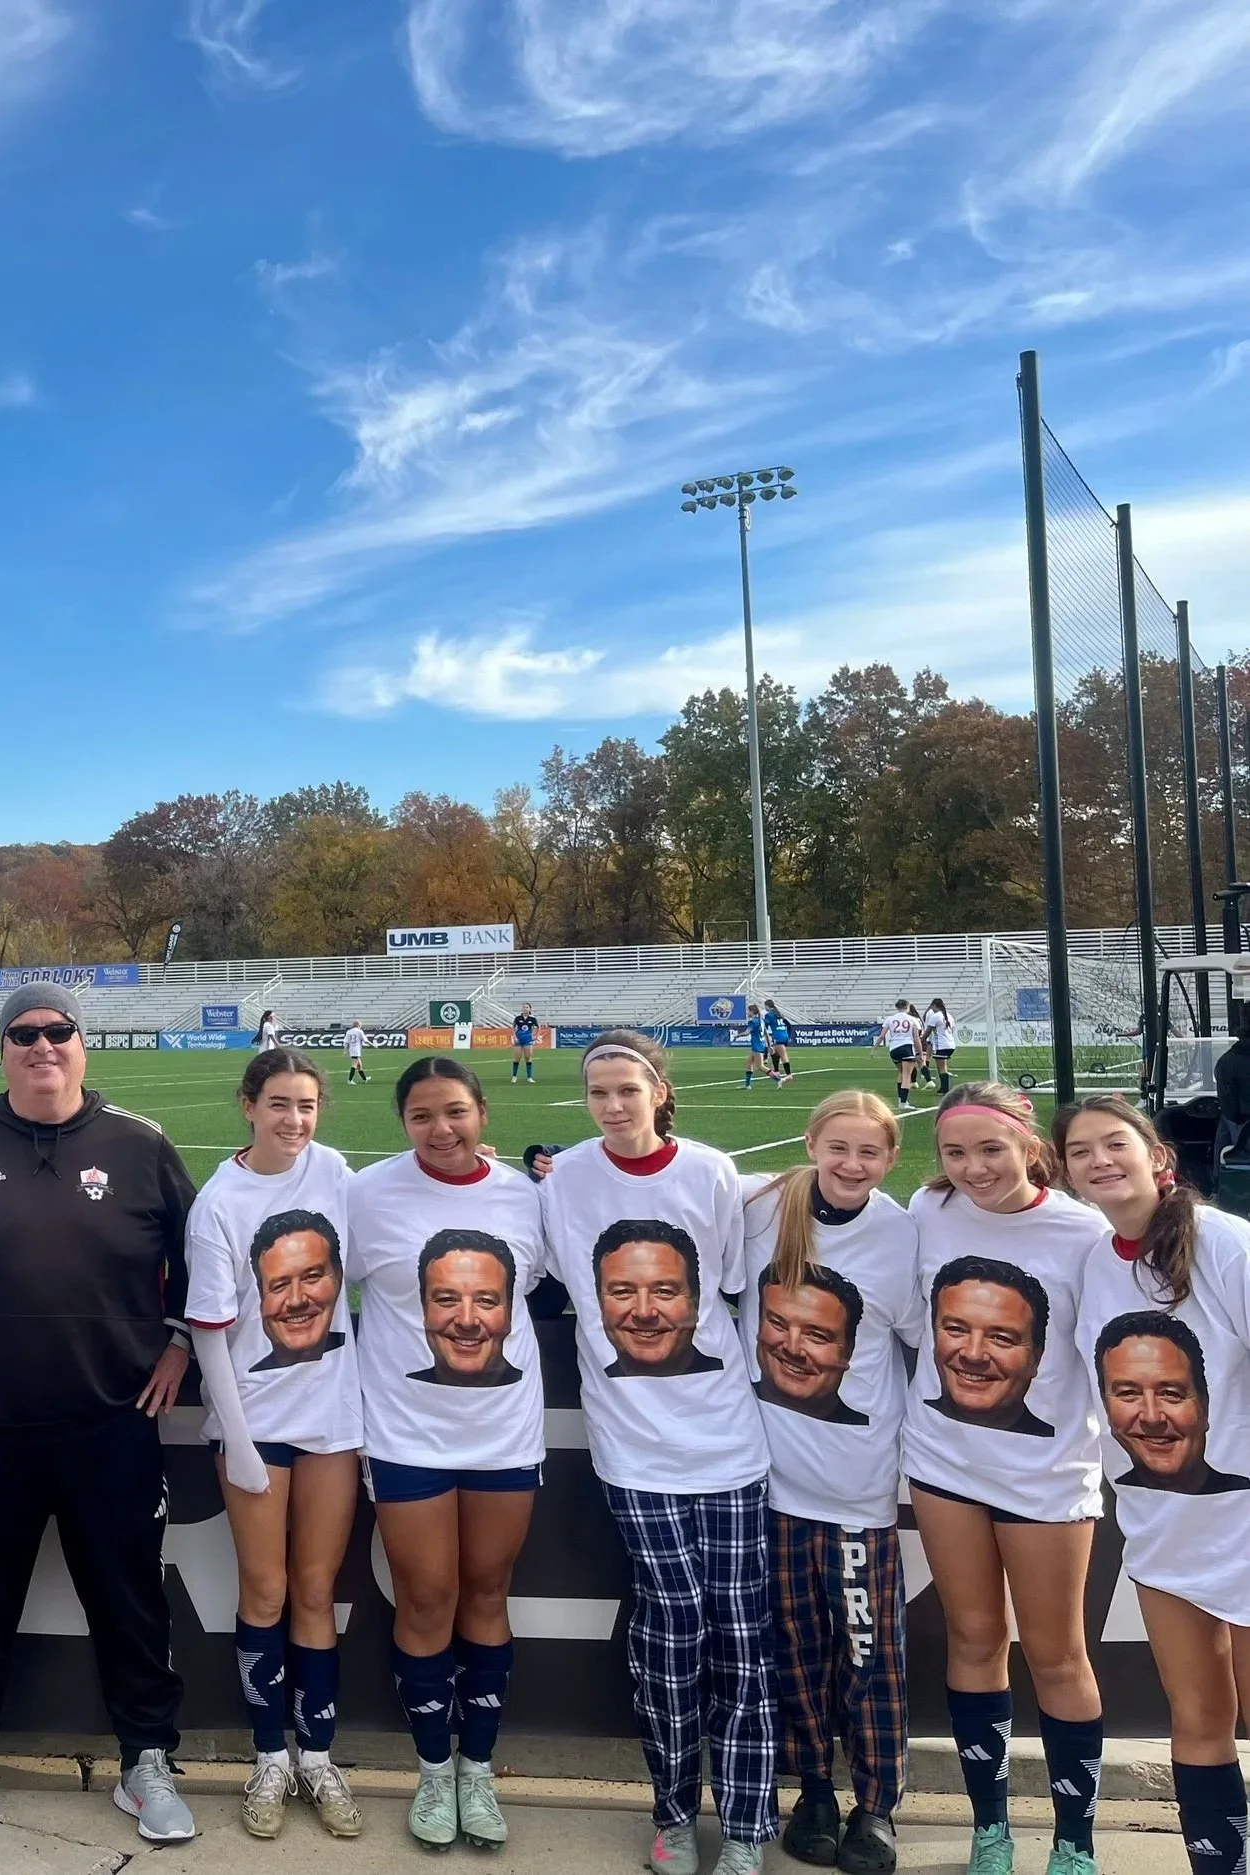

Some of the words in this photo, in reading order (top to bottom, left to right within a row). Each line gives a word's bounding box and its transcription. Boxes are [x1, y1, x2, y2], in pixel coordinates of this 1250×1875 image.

[389, 932, 449, 947] UMB
[462, 929, 510, 945] BANK
[20, 969, 95, 985] GORLOKS
[103, 967, 128, 976] Webster
[206, 1009, 234, 1018] Webster
[892, 1020, 910, 1033] 29
[105, 1034, 130, 1048] BSPC
[132, 1034, 157, 1048] BSPC
[186, 1033, 207, 1041] World
[208, 1033, 227, 1041] Wide
[796, 1037, 821, 1045] Things
